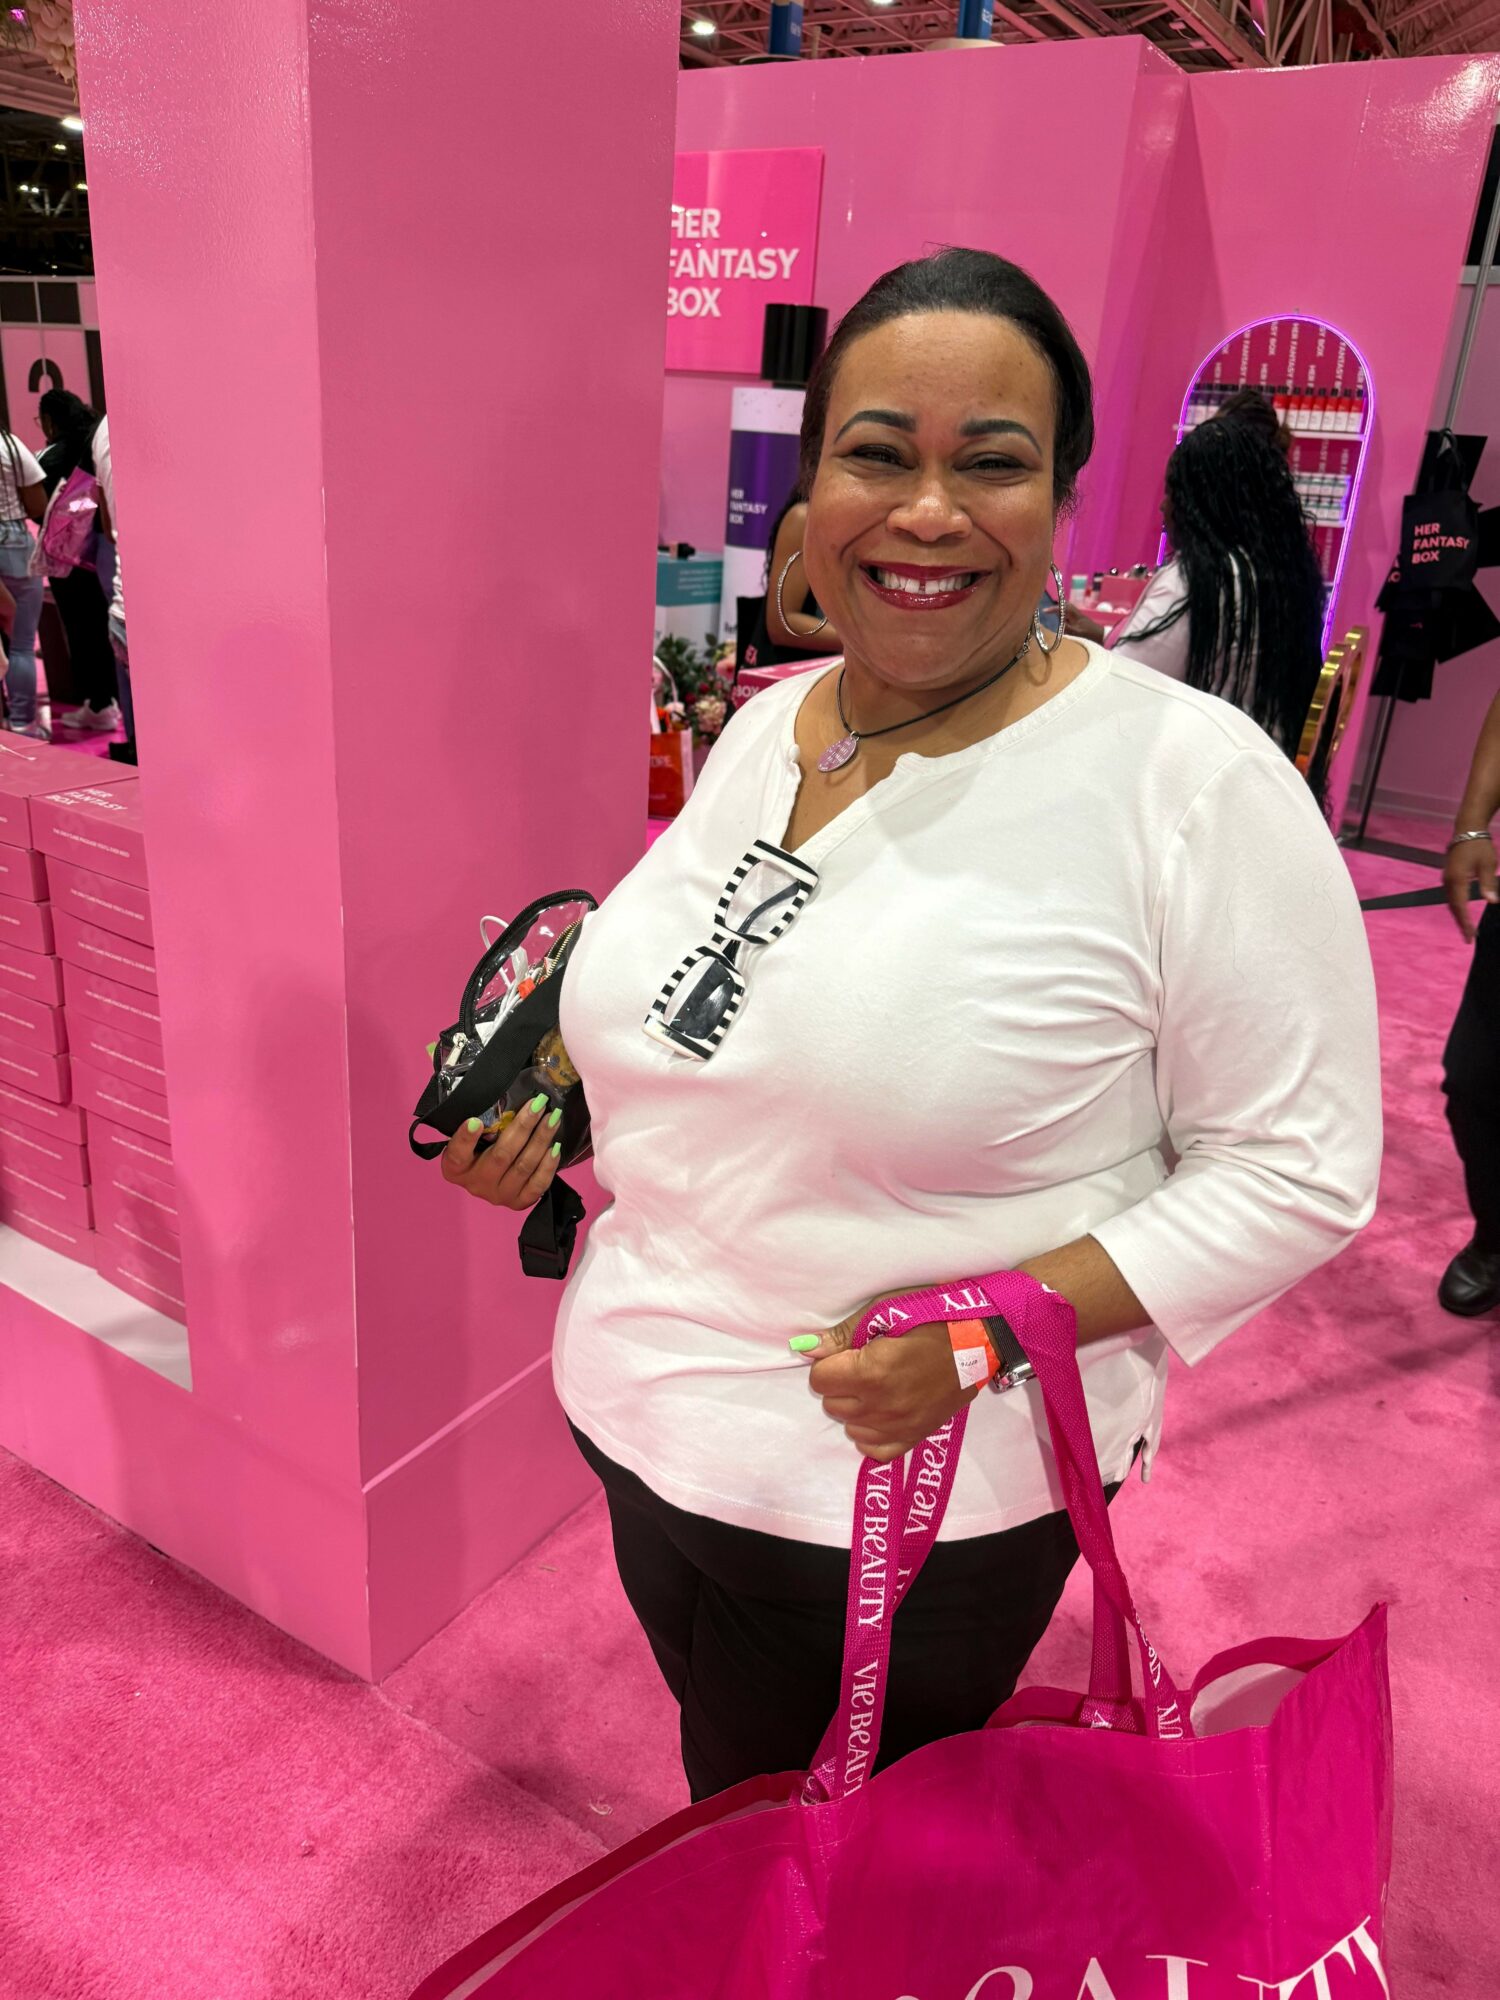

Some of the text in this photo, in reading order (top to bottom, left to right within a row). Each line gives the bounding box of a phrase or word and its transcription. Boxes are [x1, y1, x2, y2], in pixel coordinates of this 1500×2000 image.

[1414, 523, 1440, 536] HER
[1413, 536, 1469, 550] FANTASY
[1411, 551, 1439, 564] BOX
[45, 794, 79, 805] BOX
[63, 791, 128, 811] FANTASY
